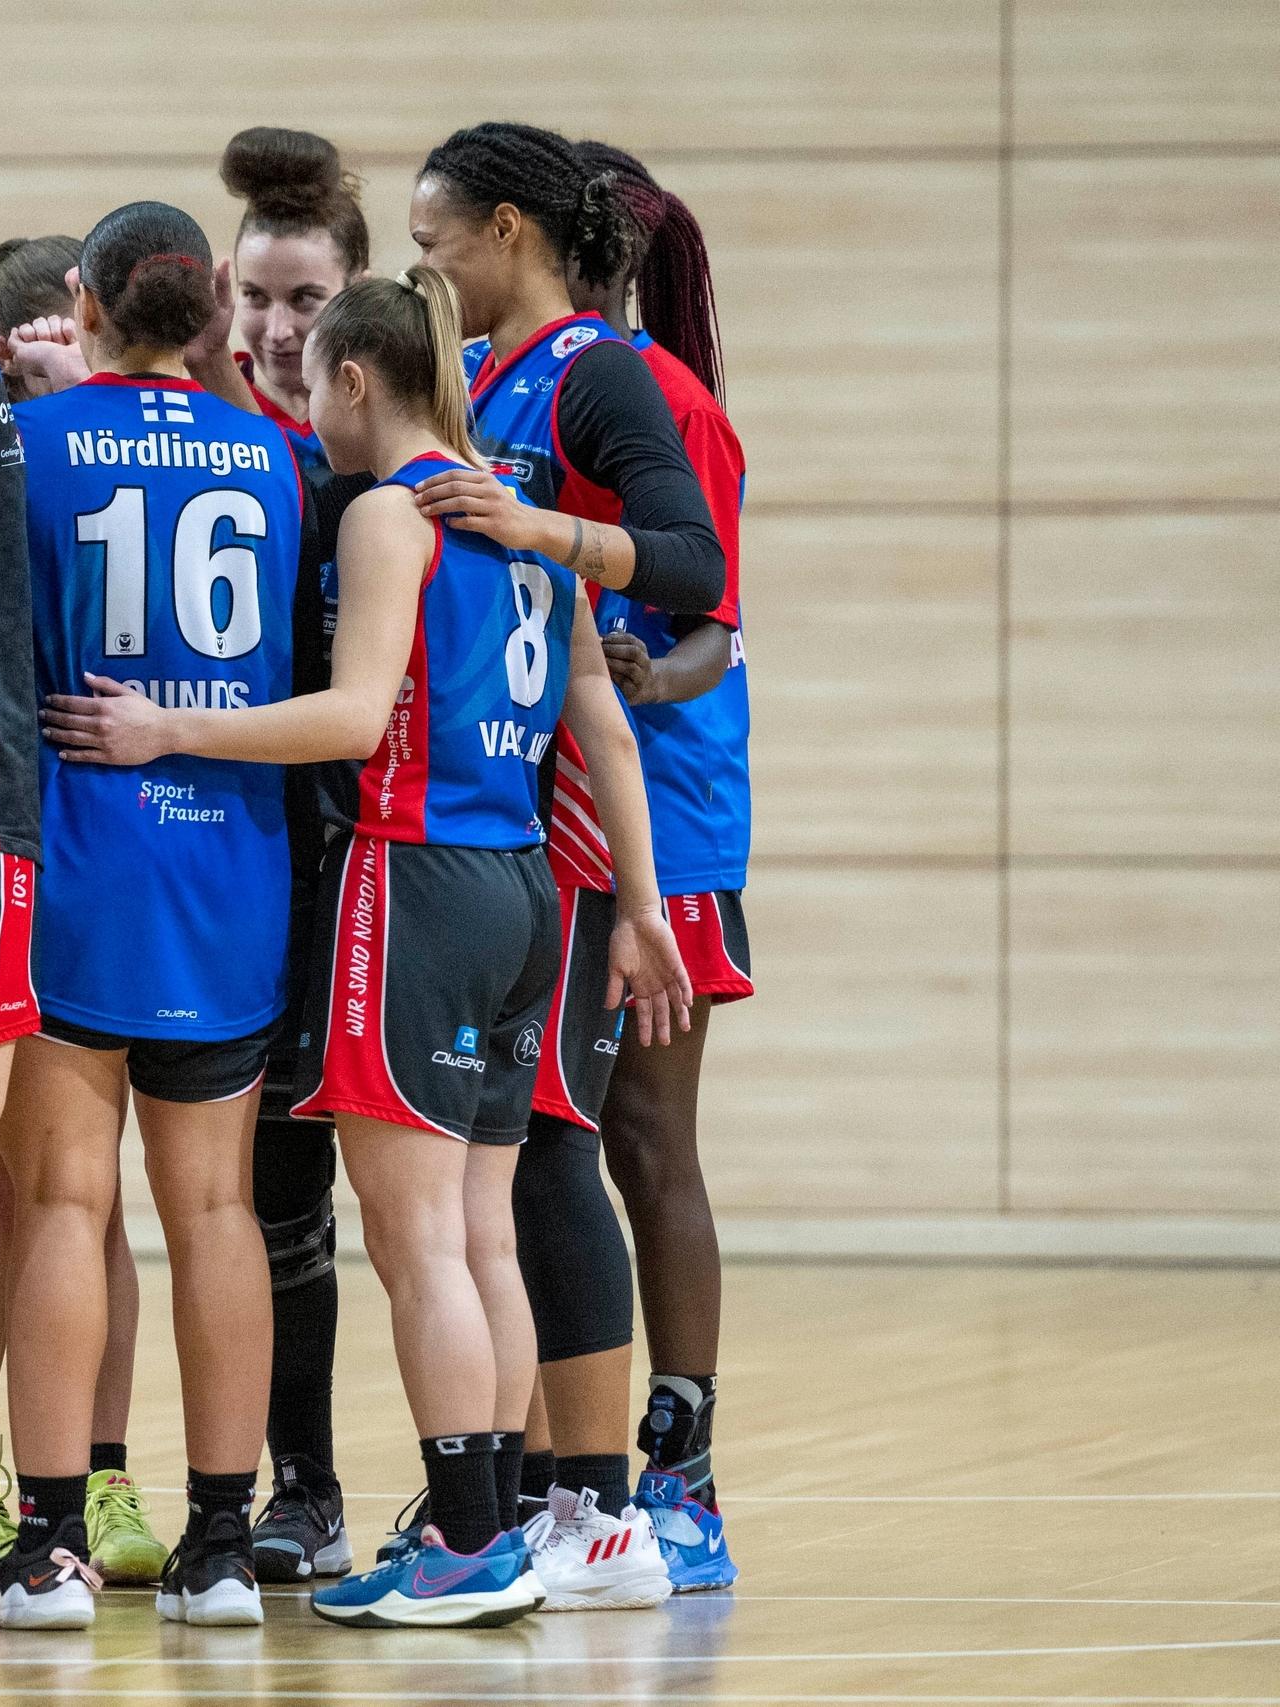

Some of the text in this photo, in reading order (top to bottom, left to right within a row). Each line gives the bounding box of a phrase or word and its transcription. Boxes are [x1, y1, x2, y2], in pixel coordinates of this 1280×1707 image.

[66, 429, 270, 476] Nördlingen
[76, 486, 268, 660] 16
[505, 561, 553, 708] 8
[399, 709, 413, 760] Graule
[380, 710, 401, 821] Gebäudetechnik
[141, 781, 195, 803] Sport
[158, 800, 225, 824] frauen
[11, 868, 28, 909] SO!
[682, 894, 701, 922] WI
[348, 944, 370, 996] SIND
[346, 998, 367, 1038] WIR
